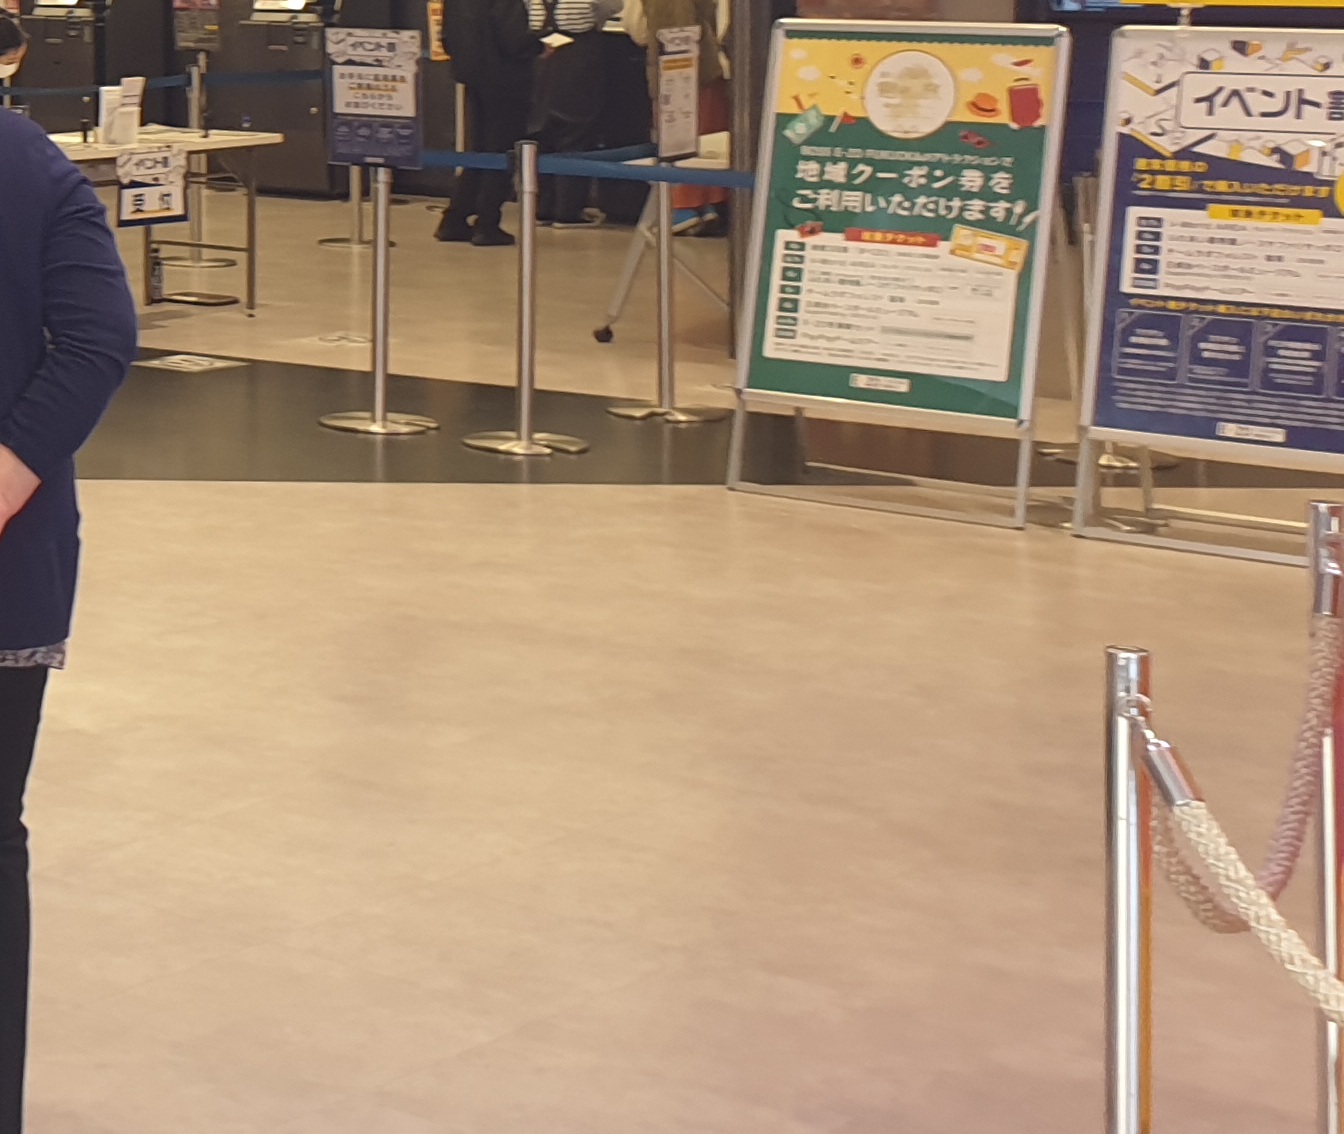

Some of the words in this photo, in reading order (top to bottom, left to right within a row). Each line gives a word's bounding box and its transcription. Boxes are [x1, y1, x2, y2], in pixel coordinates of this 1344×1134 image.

[795, 160, 1014, 195] 地域クーポン券を
